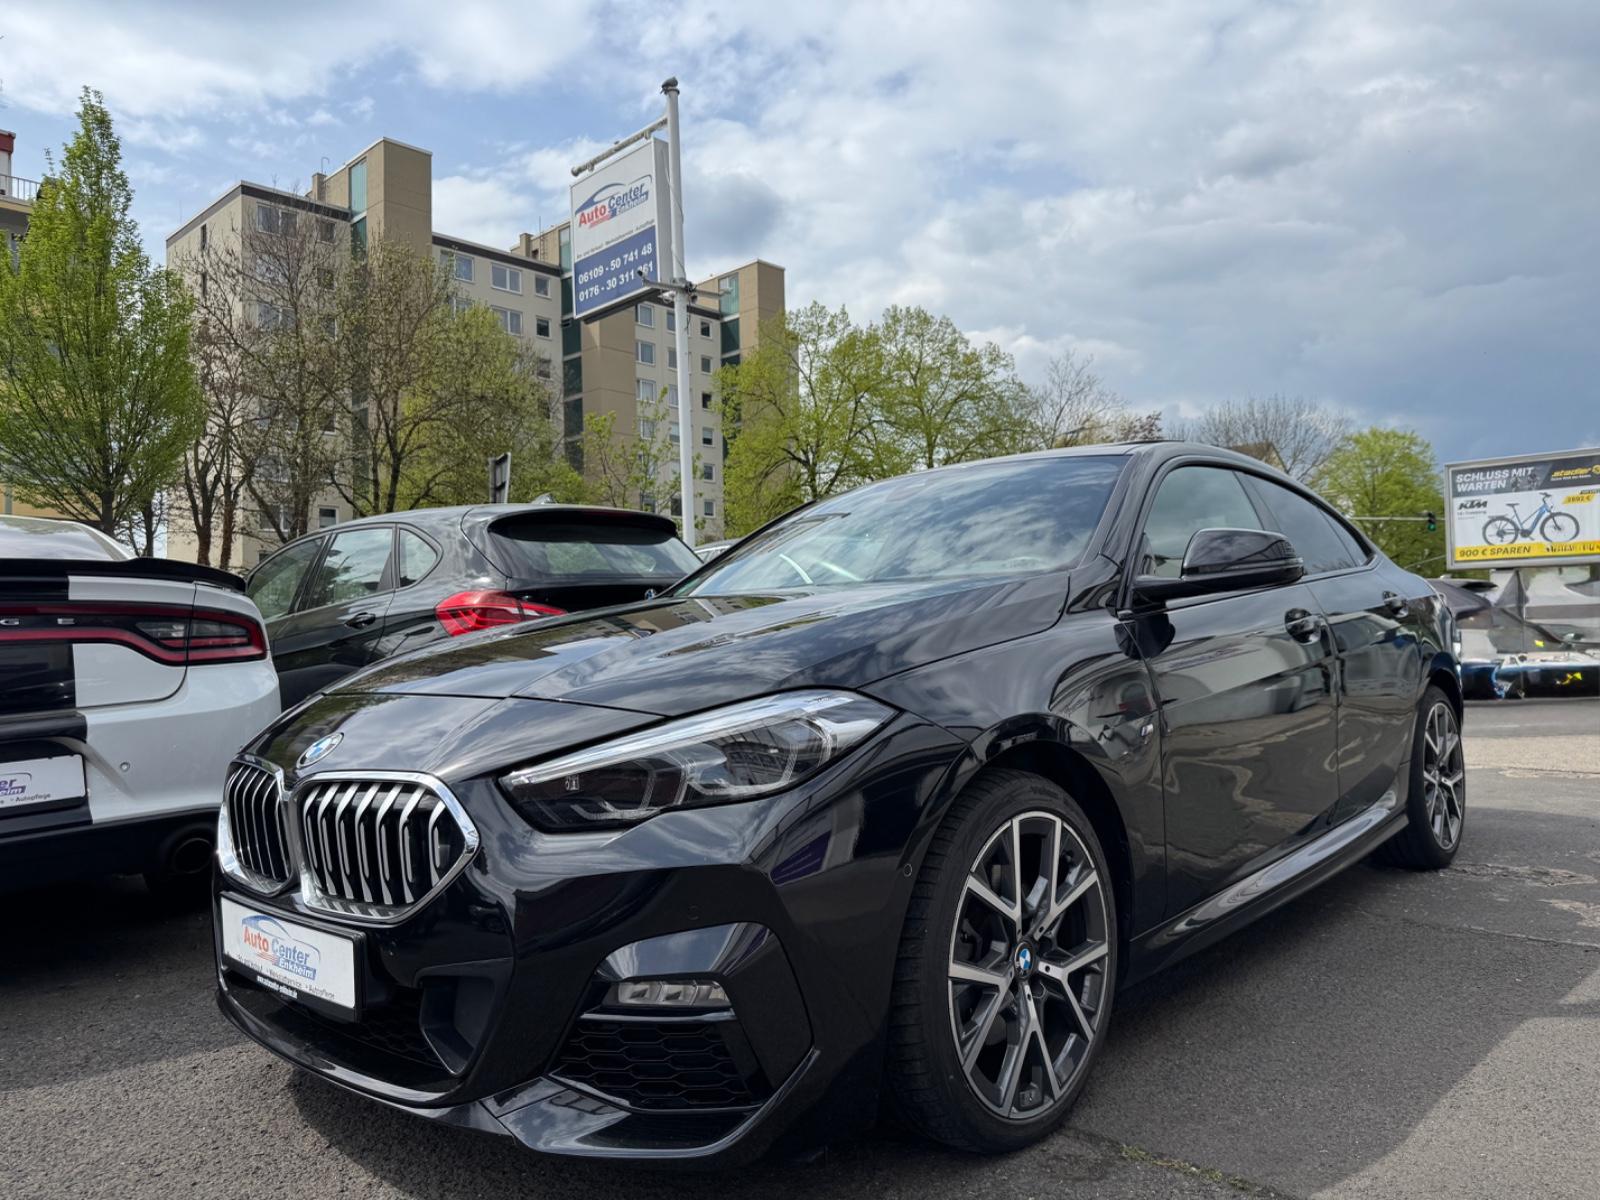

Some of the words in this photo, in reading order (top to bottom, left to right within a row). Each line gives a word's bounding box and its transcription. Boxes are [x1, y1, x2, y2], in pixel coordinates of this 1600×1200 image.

[579, 205, 606, 226] Auto
[608, 183, 645, 208] Center
[578, 265, 604, 285] 06109
[610, 257, 621, 271] 50
[622, 248, 638, 265] 741
[641, 242, 653, 256] 48
[579, 285, 599, 301] 0176
[606, 277, 617, 291] 30
[619, 269, 634, 285] 311
[1456, 469, 1510, 483] SCHLUSS
[1511, 466, 1534, 477] MIT
[1457, 479, 1507, 492] WARTEN
[1458, 500, 1488, 510] KTM
[1460, 549, 1478, 558] 900
[1481, 548, 1487, 556] €
[1490, 546, 1531, 556] SPAREN
[243, 926, 269, 952] Auto
[271, 939, 310, 964] Center
